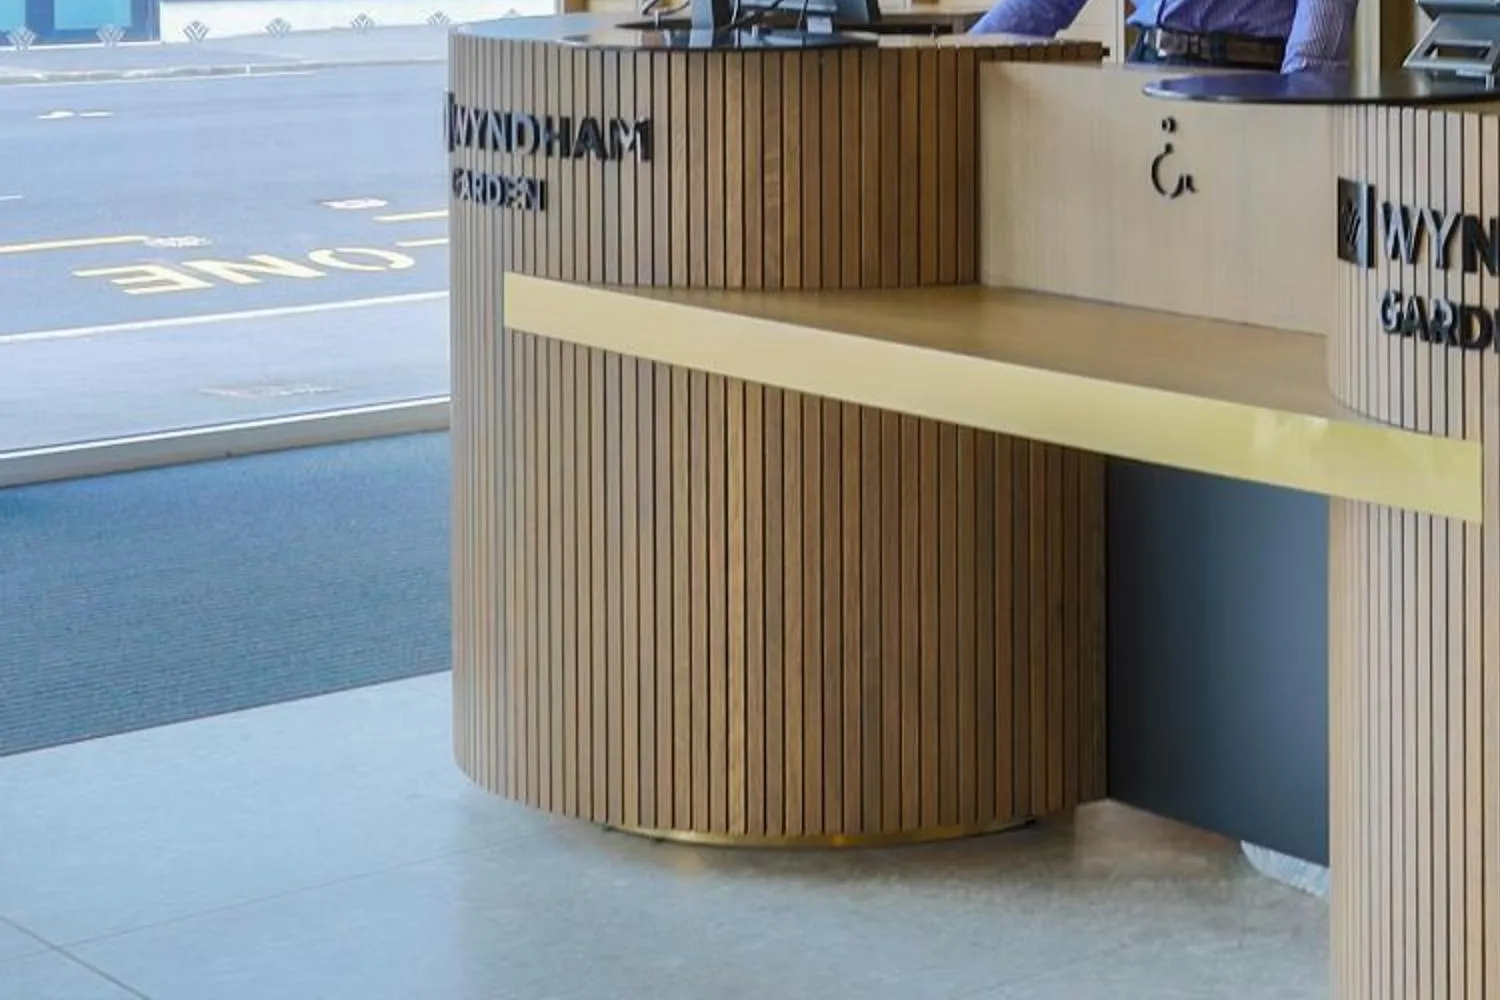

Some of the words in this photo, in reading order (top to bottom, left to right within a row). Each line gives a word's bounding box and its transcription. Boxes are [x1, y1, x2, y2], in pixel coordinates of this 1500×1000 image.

[452, 103, 653, 163] WYNDHAM
[452, 167, 545, 211] GARDEN
[73, 238, 449, 295] ONE
